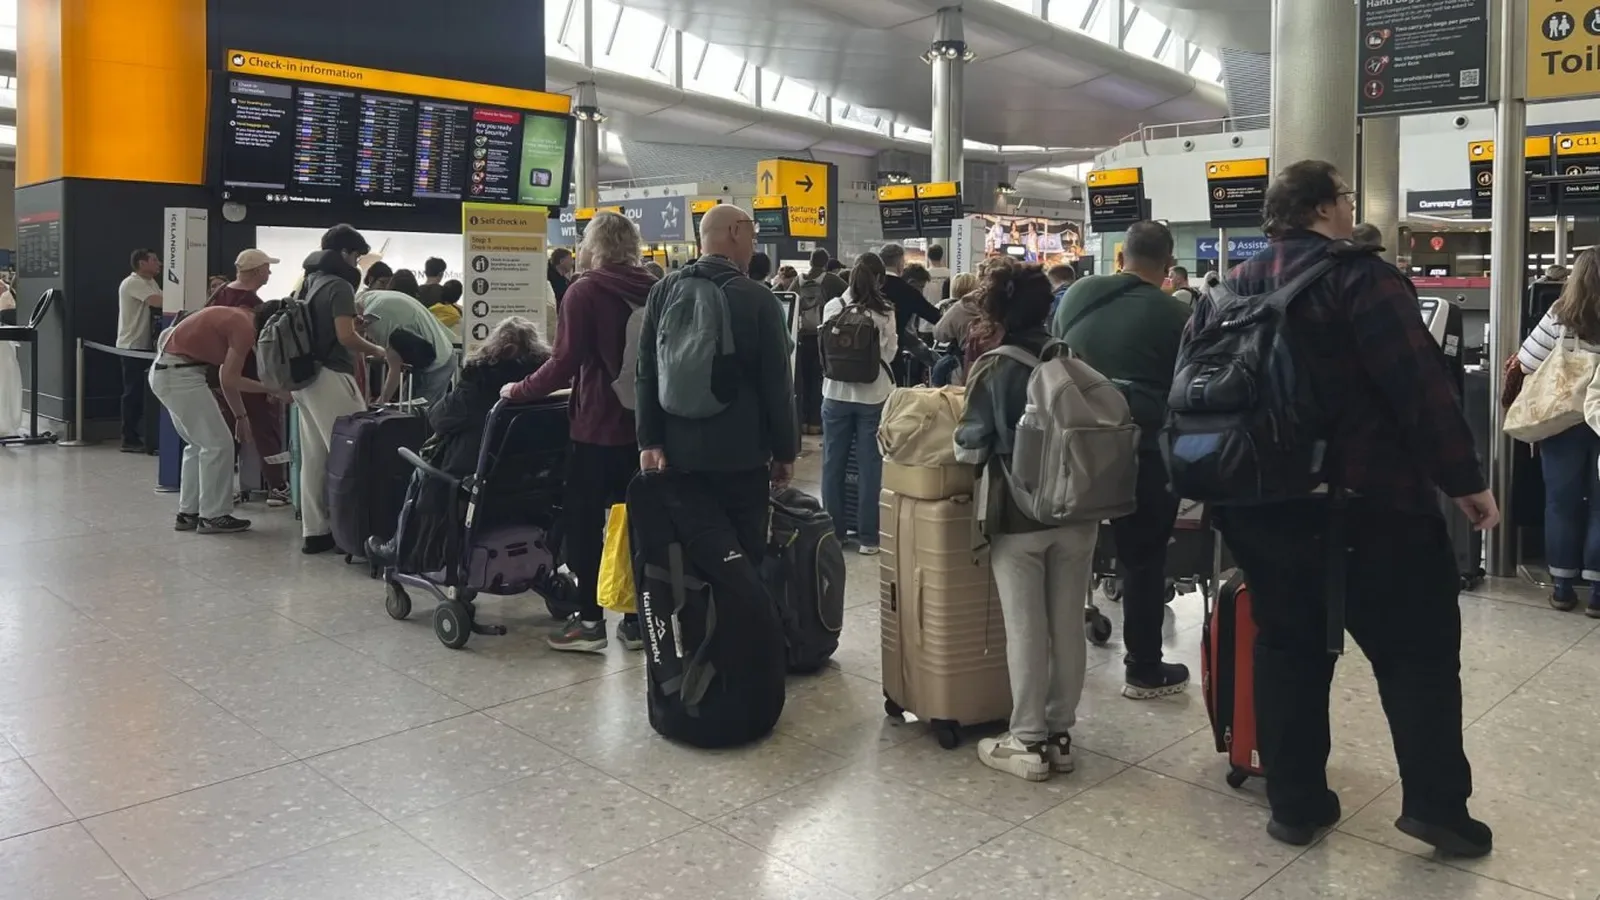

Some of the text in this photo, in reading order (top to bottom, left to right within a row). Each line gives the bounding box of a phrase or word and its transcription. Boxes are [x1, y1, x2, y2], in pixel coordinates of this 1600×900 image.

[248, 56, 363, 80] Check-in information
[497, 124, 513, 132] ready
[484, 129, 508, 137] Security?
[1577, 137, 1598, 146] C11
[1580, 184, 1599, 192] closed
[1419, 199, 1456, 208] Currency
[790, 205, 817, 213] partures
[480, 217, 495, 225] Self
[560, 212, 575, 223] CO
[791, 214, 817, 225] Security
[561, 226, 576, 236] WIT
[1237, 240, 1269, 249] Assista
[642, 591, 661, 663] Kathmandu
